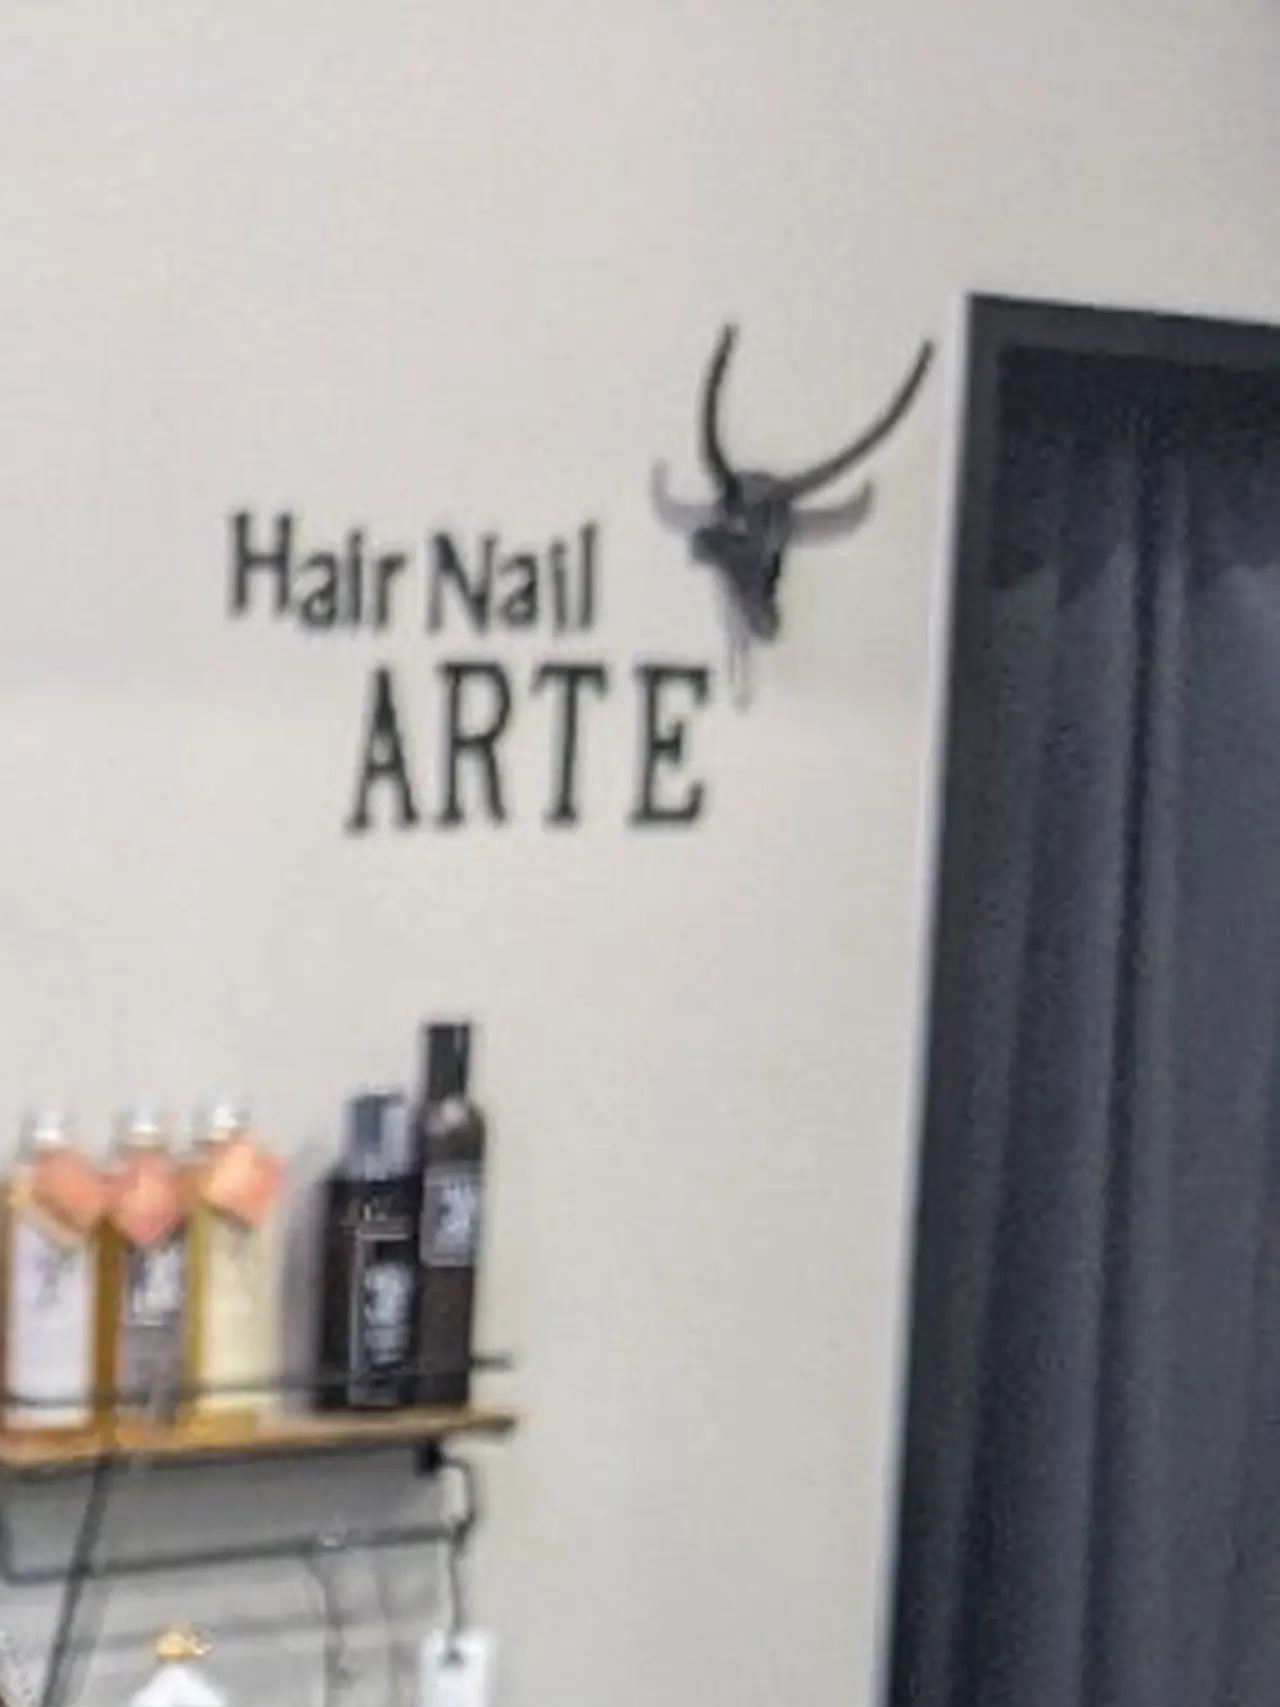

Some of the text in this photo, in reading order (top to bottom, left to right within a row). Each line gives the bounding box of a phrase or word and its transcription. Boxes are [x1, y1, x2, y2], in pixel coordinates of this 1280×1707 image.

[227, 510, 598, 634] Hair Nail
[344, 660, 711, 836] ARTE
